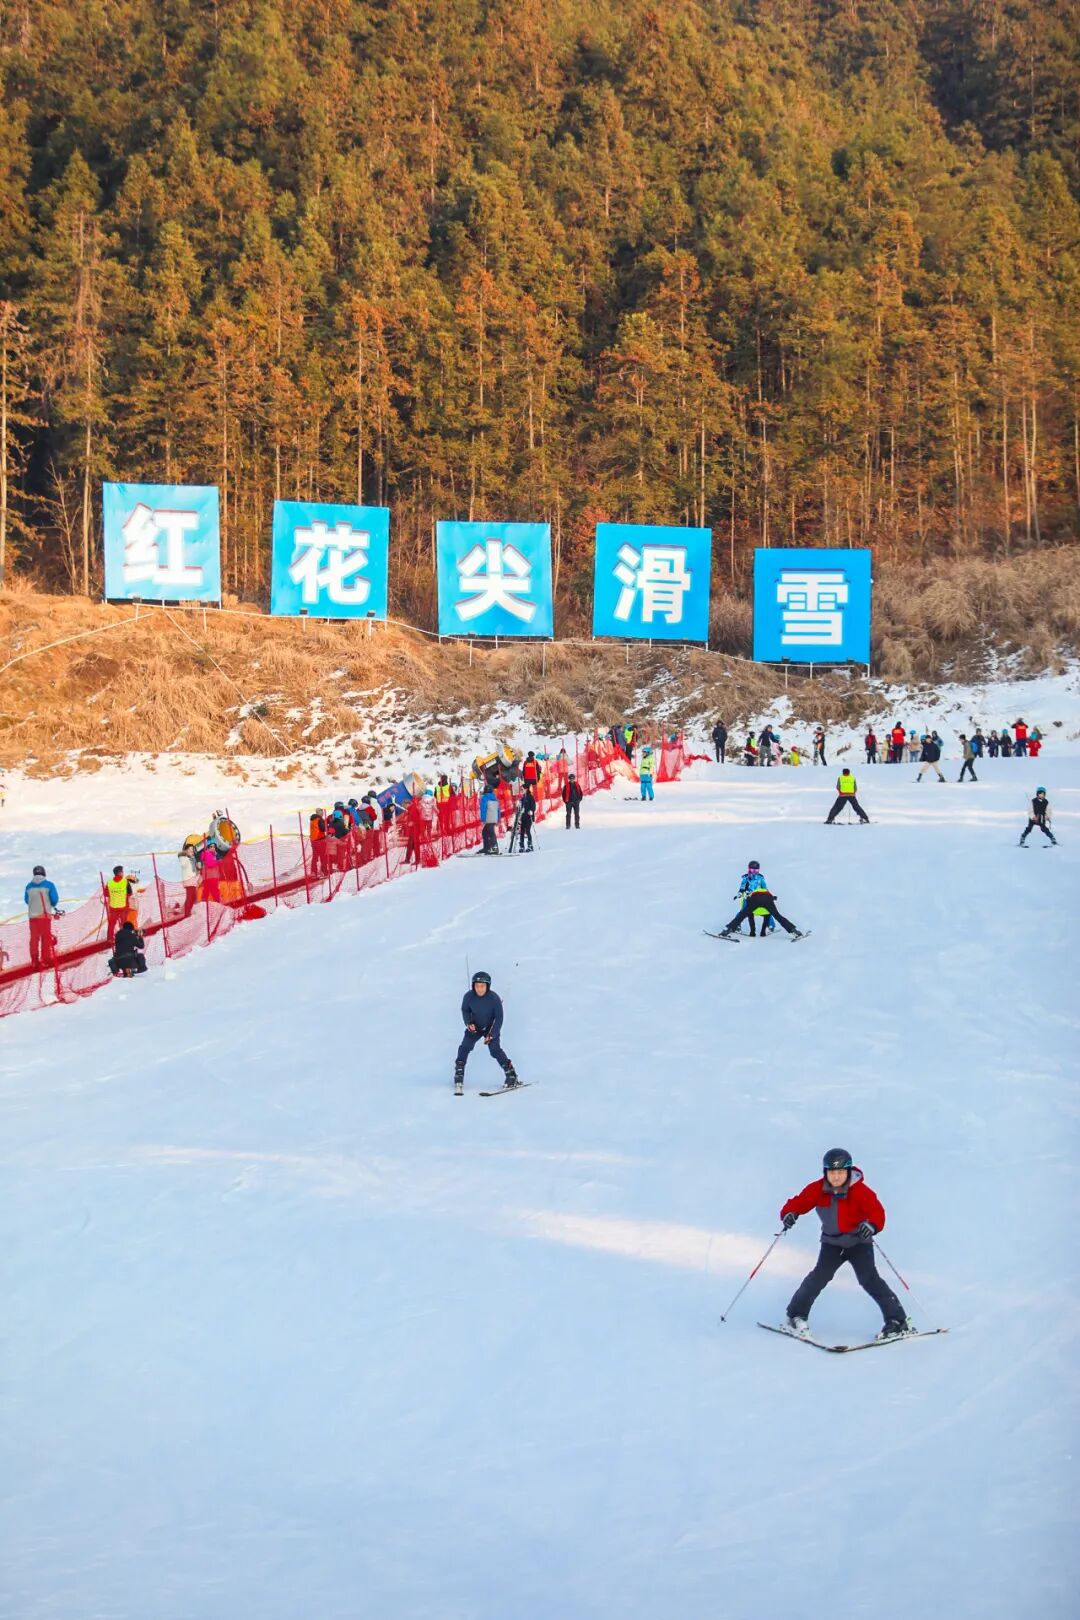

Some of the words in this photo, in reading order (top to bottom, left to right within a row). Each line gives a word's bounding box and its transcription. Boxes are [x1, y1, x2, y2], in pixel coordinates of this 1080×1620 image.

[121, 502, 203, 587] 红
[290, 520, 369, 603] 花
[456, 540, 535, 621] 尖
[614, 545, 691, 623] 滑
[776, 568, 849, 645] 雪
